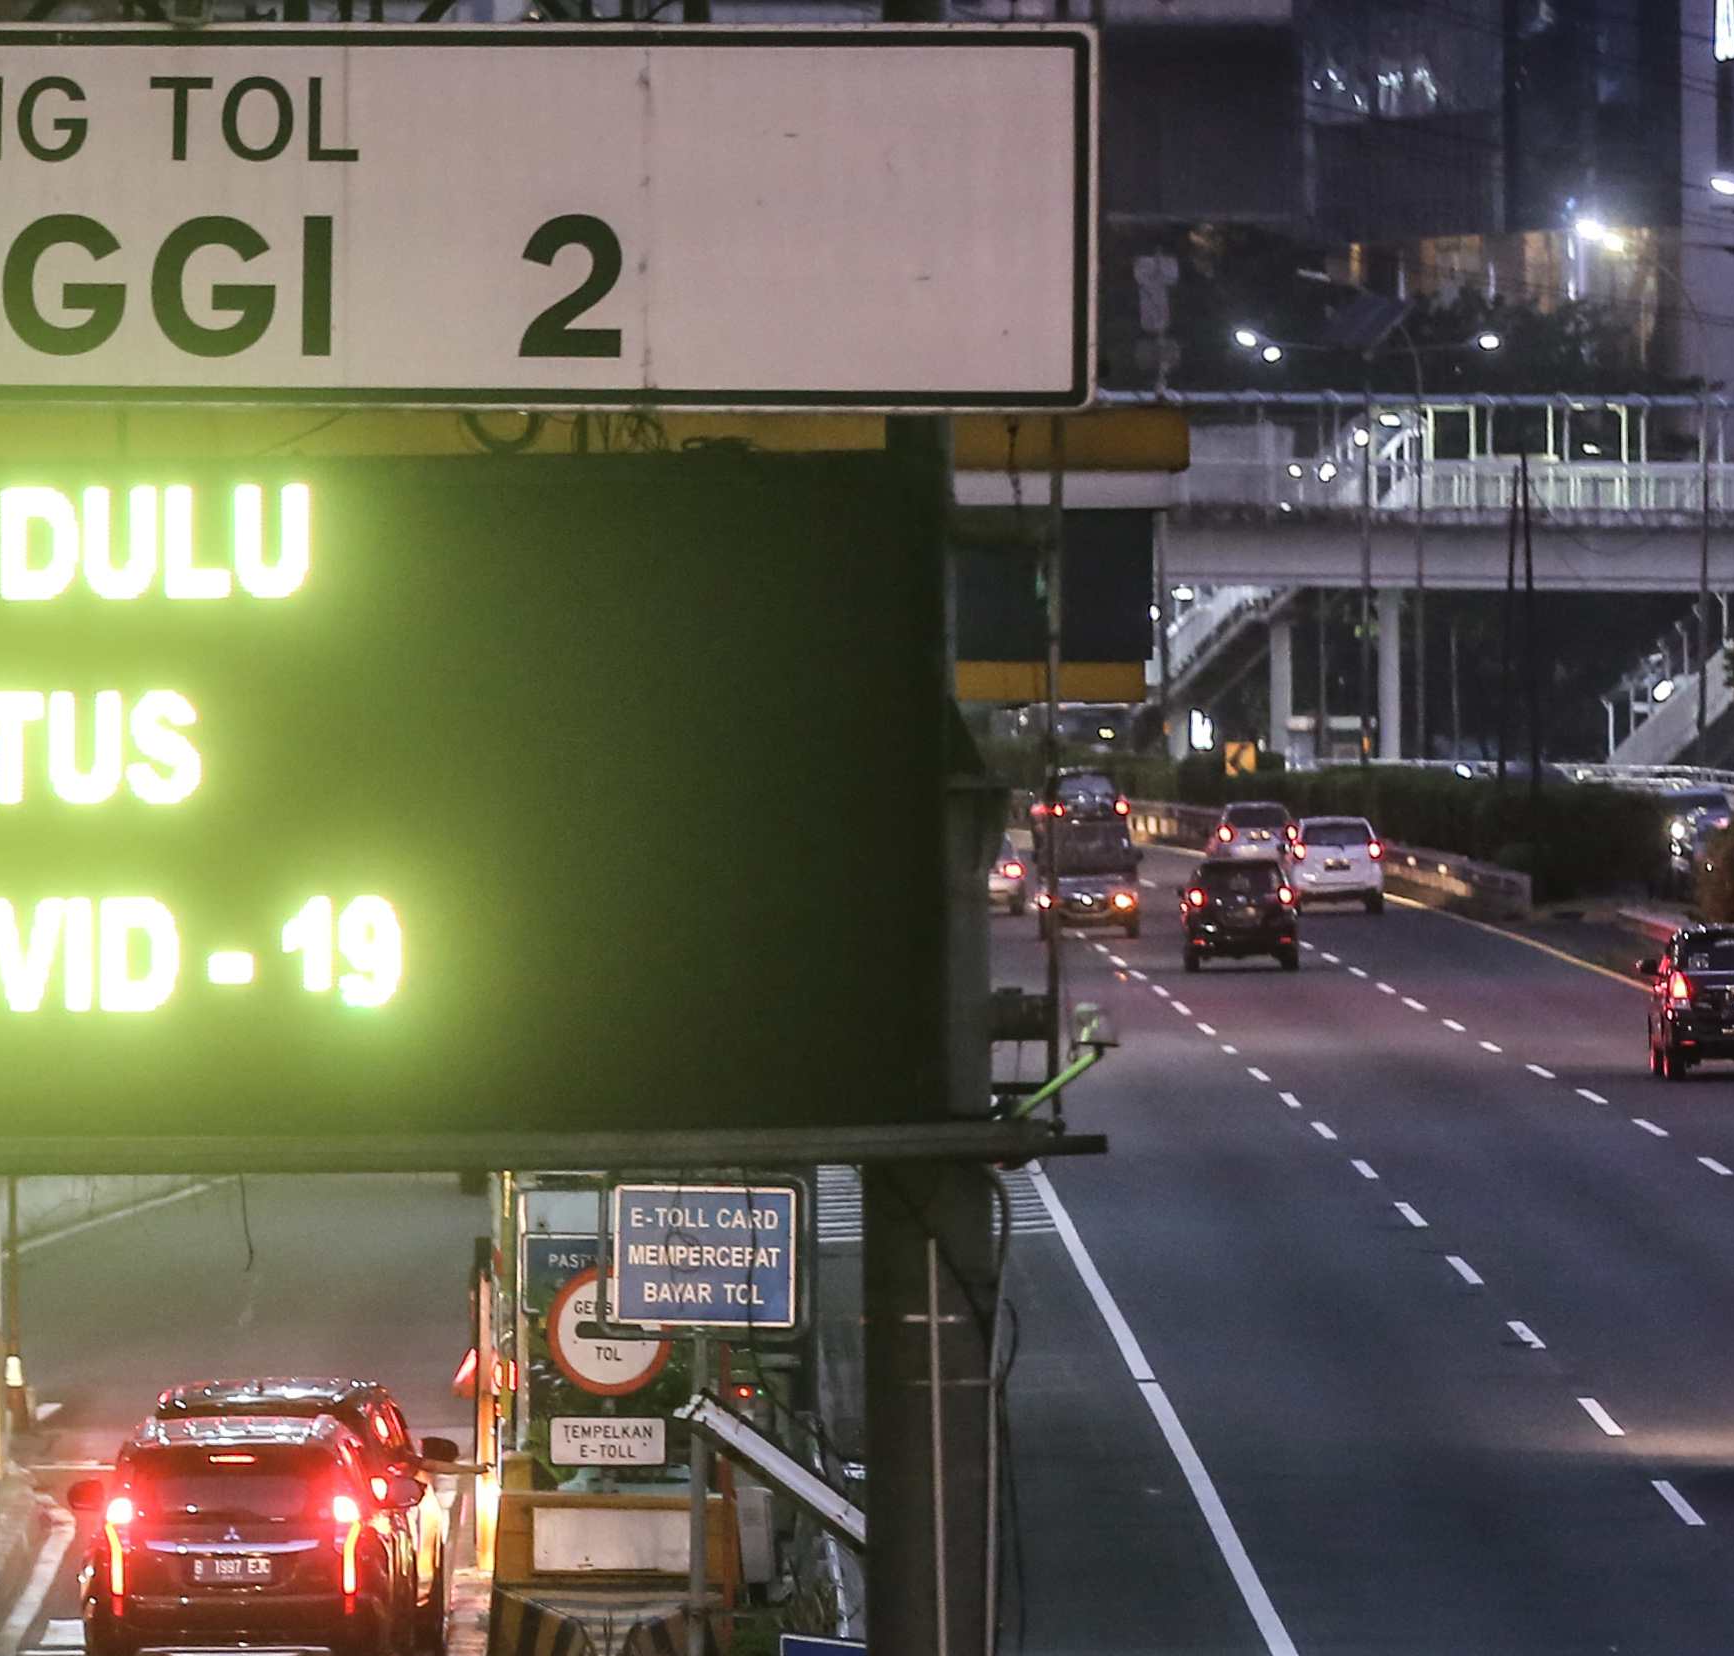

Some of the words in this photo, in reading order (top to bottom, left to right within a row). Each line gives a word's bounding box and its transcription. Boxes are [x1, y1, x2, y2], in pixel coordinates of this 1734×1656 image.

[150, 75, 359, 162] TOL
[517, 213, 623, 358] 2
[0, 484, 311, 600] DULU
[281, 894, 404, 1007] 19
[630, 1207, 709, 1229] E-TOLL
[717, 1209, 780, 1230] CARD
[628, 1245, 781, 1268] MEMPERCEPAT
[643, 1282, 712, 1304] BAYAR
[595, 1346, 622, 1361] TOL
[563, 1424, 653, 1439] TEMPELKAN
[580, 1444, 636, 1458] E-TOLL
